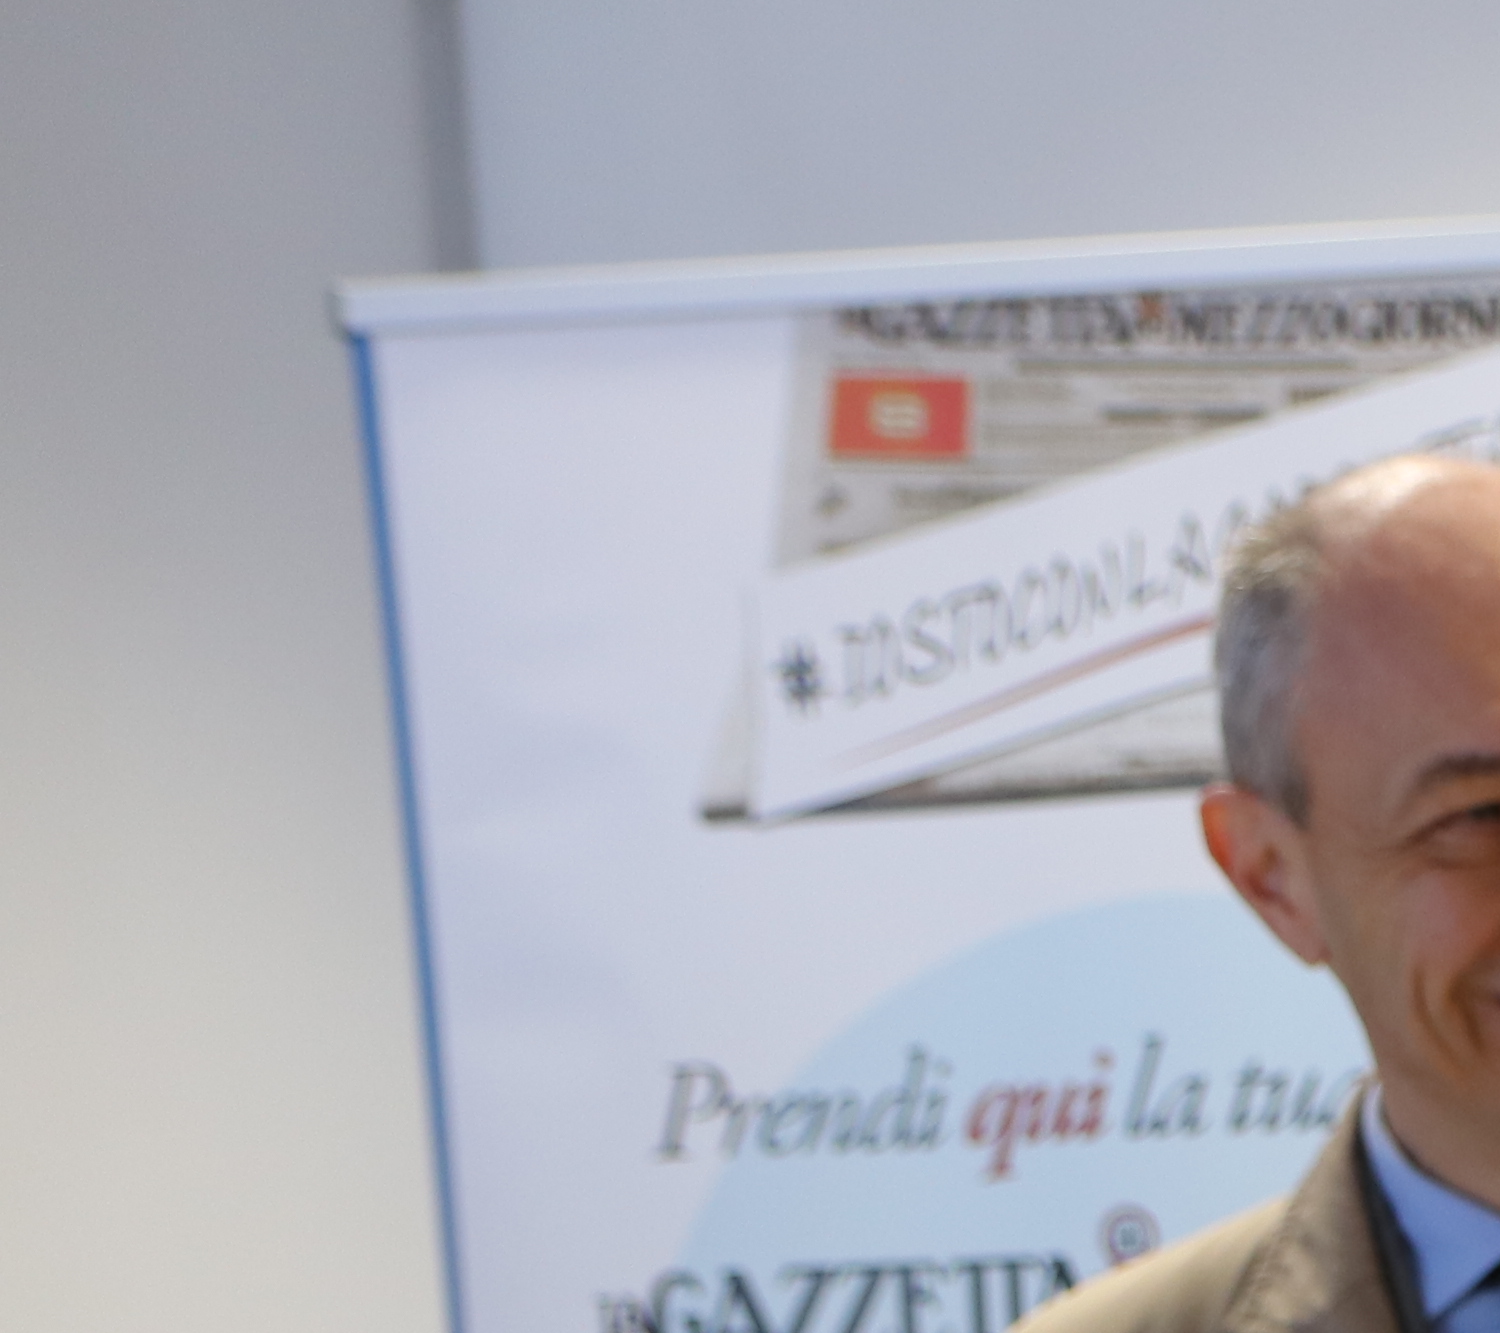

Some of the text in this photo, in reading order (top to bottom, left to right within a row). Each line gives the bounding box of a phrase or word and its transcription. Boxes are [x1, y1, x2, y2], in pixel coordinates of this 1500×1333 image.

[652, 1042, 954, 1163] Prendi
[965, 1053, 1116, 1184] qui
[1122, 1030, 1212, 1140] la
